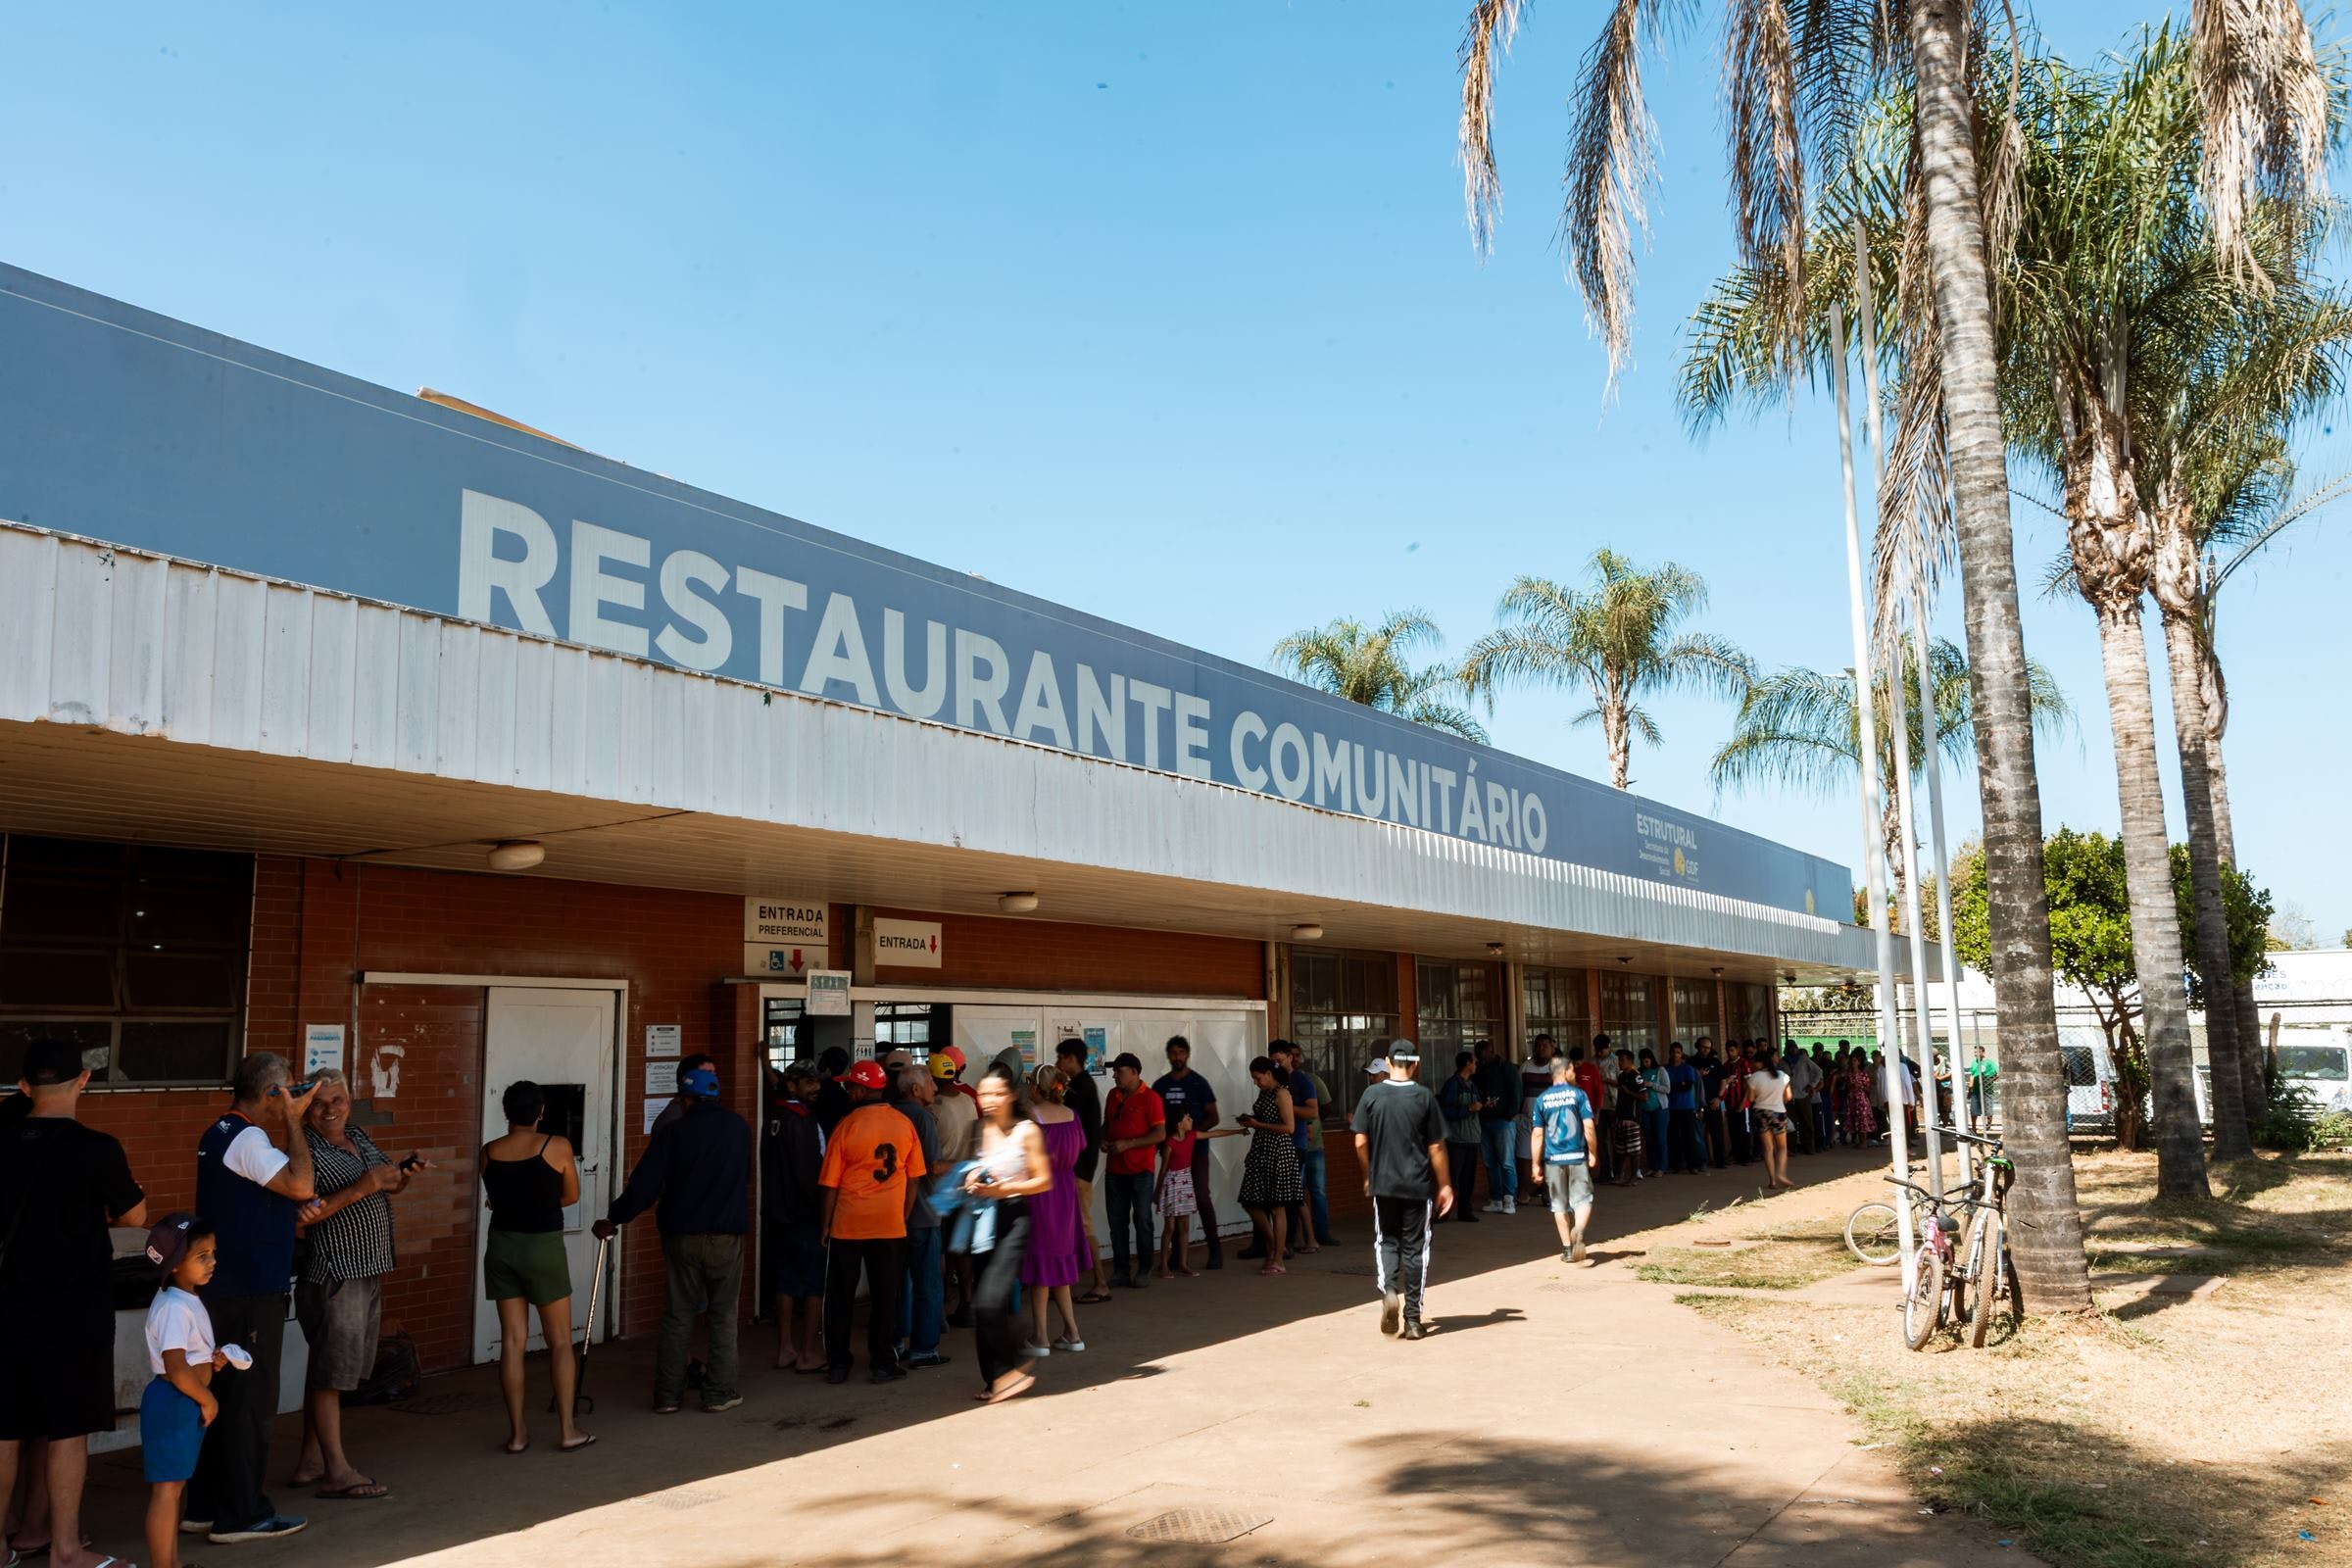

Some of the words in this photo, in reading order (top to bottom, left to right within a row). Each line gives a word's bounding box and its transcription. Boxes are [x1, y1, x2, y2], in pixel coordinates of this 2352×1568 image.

[458, 487, 1211, 782] RESTAURANTE
[1230, 710, 1547, 855] COMUNITÁRIO
[1637, 813, 1697, 850] ESTRUTURAL
[759, 906, 824, 923] ENTRADA
[759, 924, 824, 938] PREFERENCIAL
[879, 935, 926, 951] ENTRADA
[873, 1143, 898, 1184] 3
